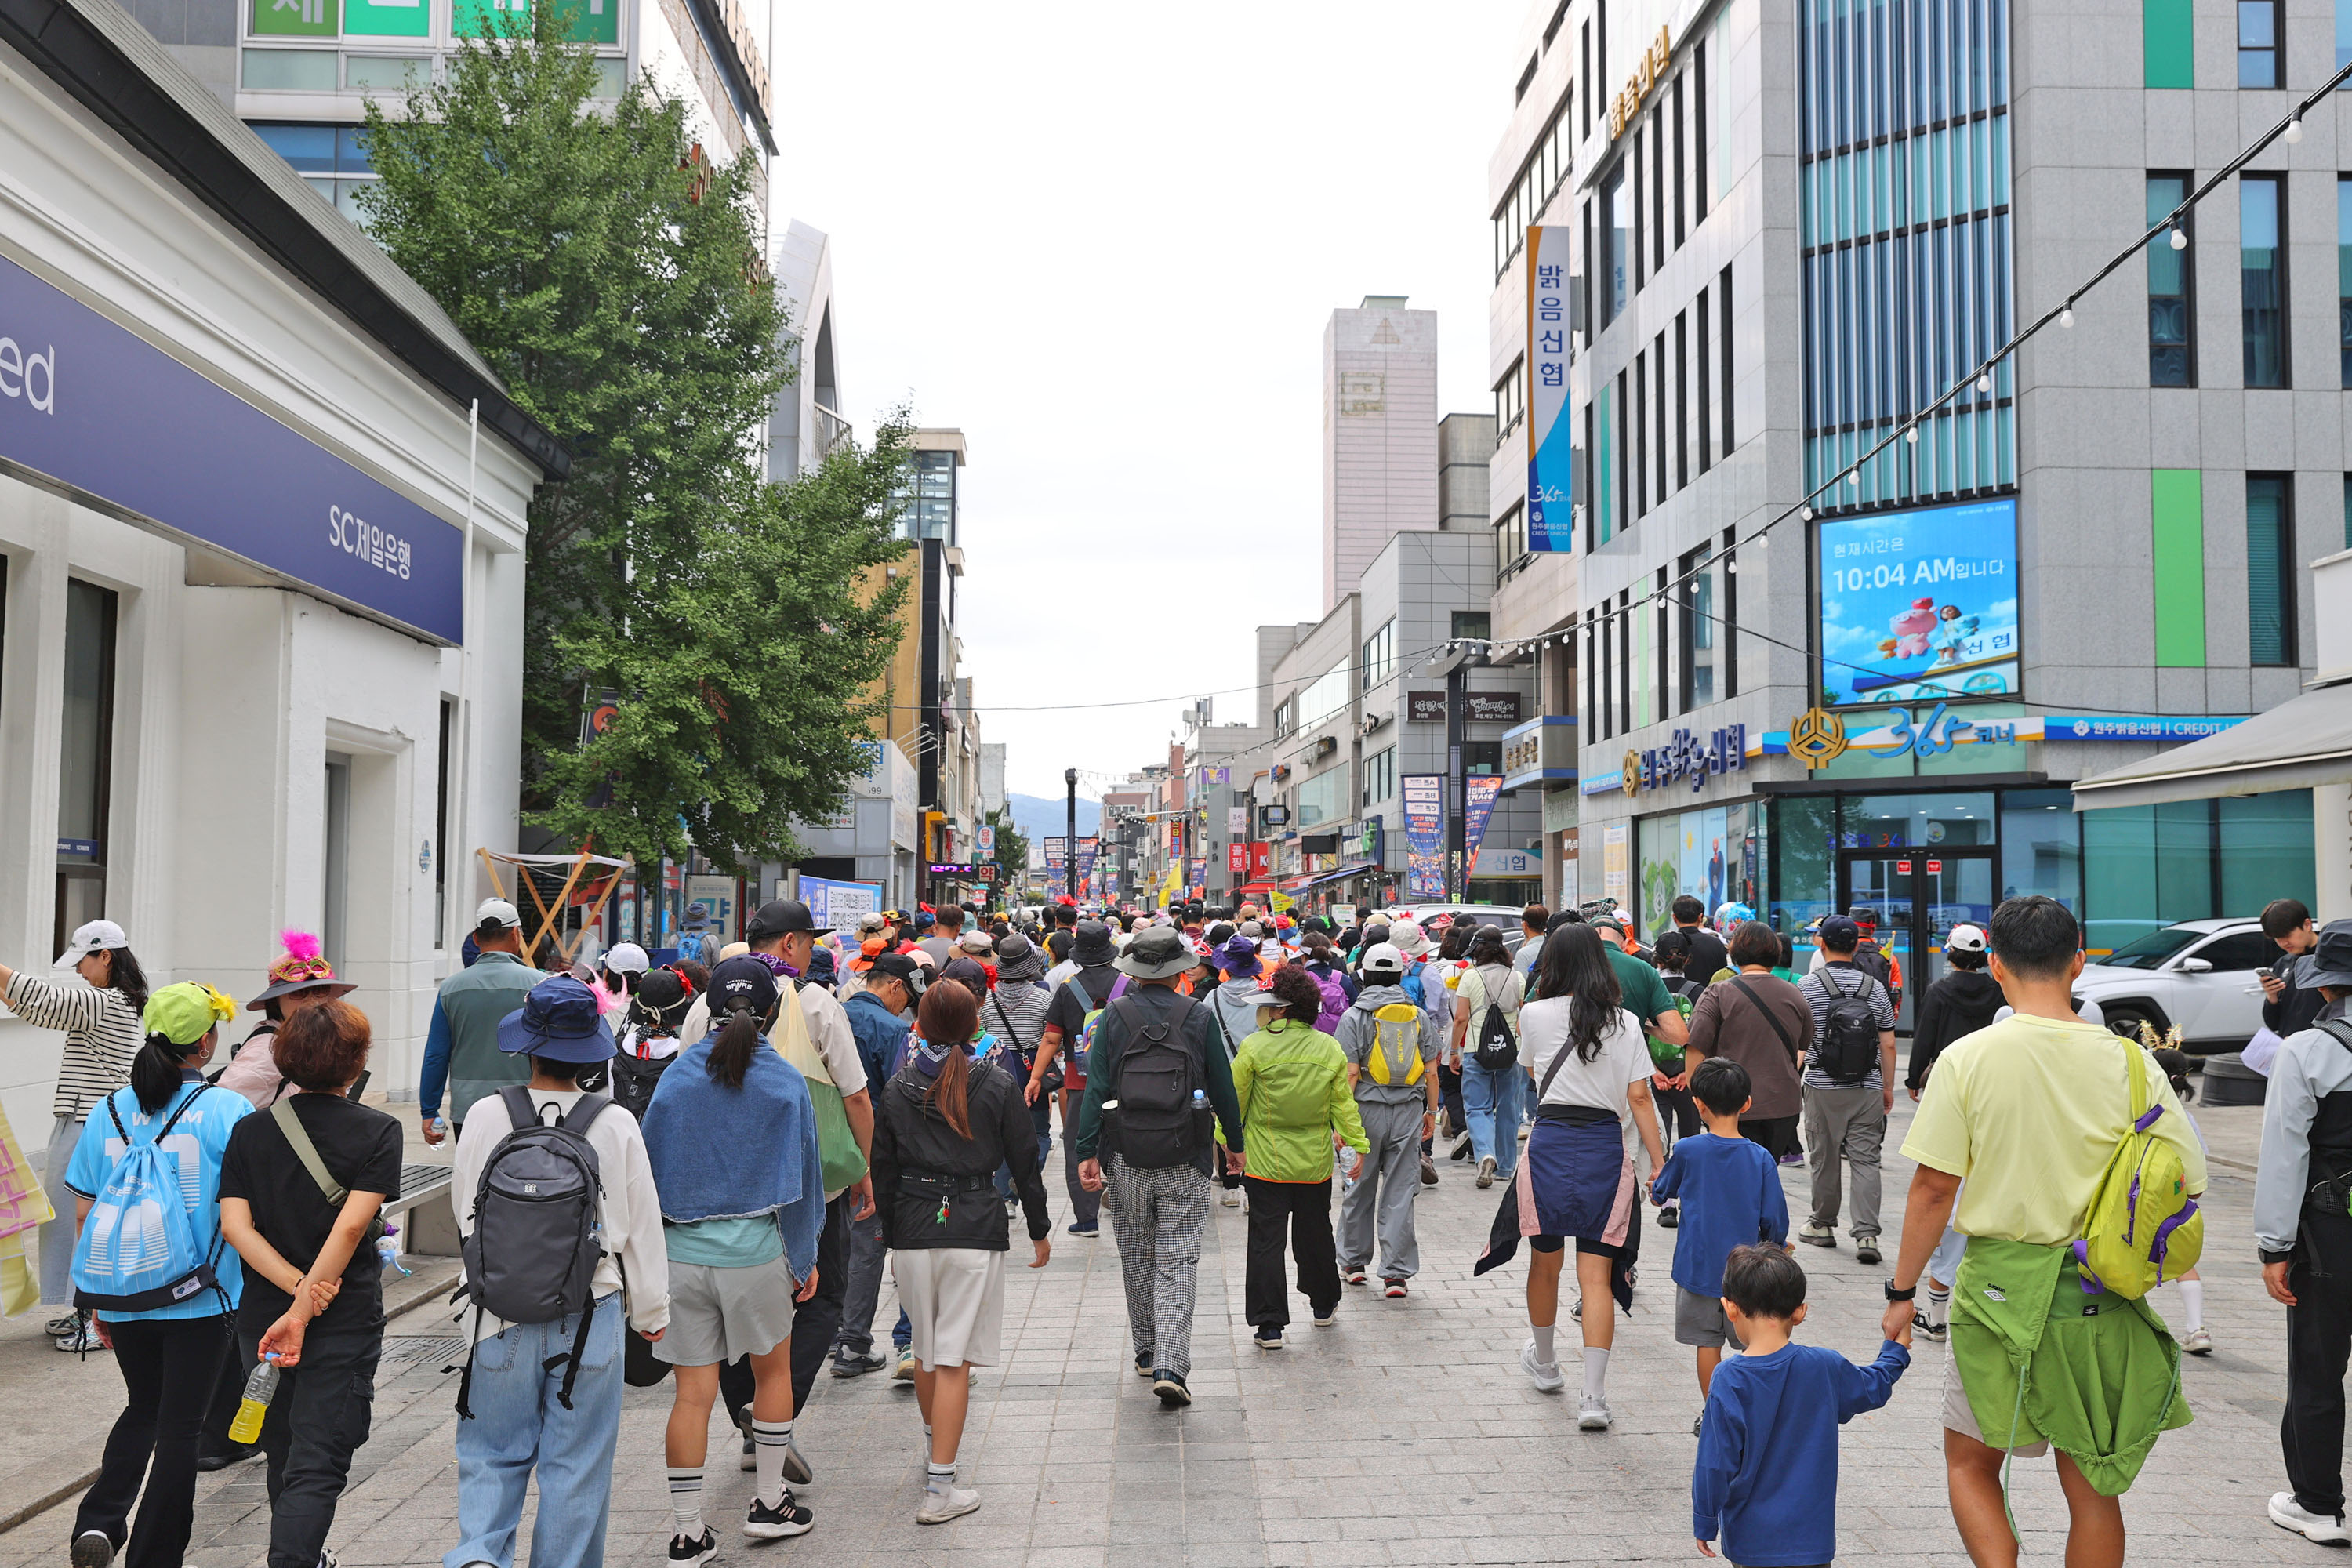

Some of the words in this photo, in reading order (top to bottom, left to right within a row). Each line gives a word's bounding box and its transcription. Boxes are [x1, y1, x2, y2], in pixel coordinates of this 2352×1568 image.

[1610, 24, 1670, 141] 밝음의원
[1538, 265, 1564, 387] 밝음신협
[1530, 485, 1564, 502] 365
[329, 504, 412, 581] SC제일은행
[1833, 536, 1904, 559] 현재시간은
[1832, 562, 1907, 593] 10:04
[1869, 702, 1973, 759] 365
[1972, 723, 2016, 746] 코너
[2092, 722, 2161, 735] 원주밝음신협
[2173, 722, 2222, 735] CREDIT
[980, 866, 994, 881] 약
[725, 982, 753, 993] SPURS
[84, 1198, 170, 1276] 10
